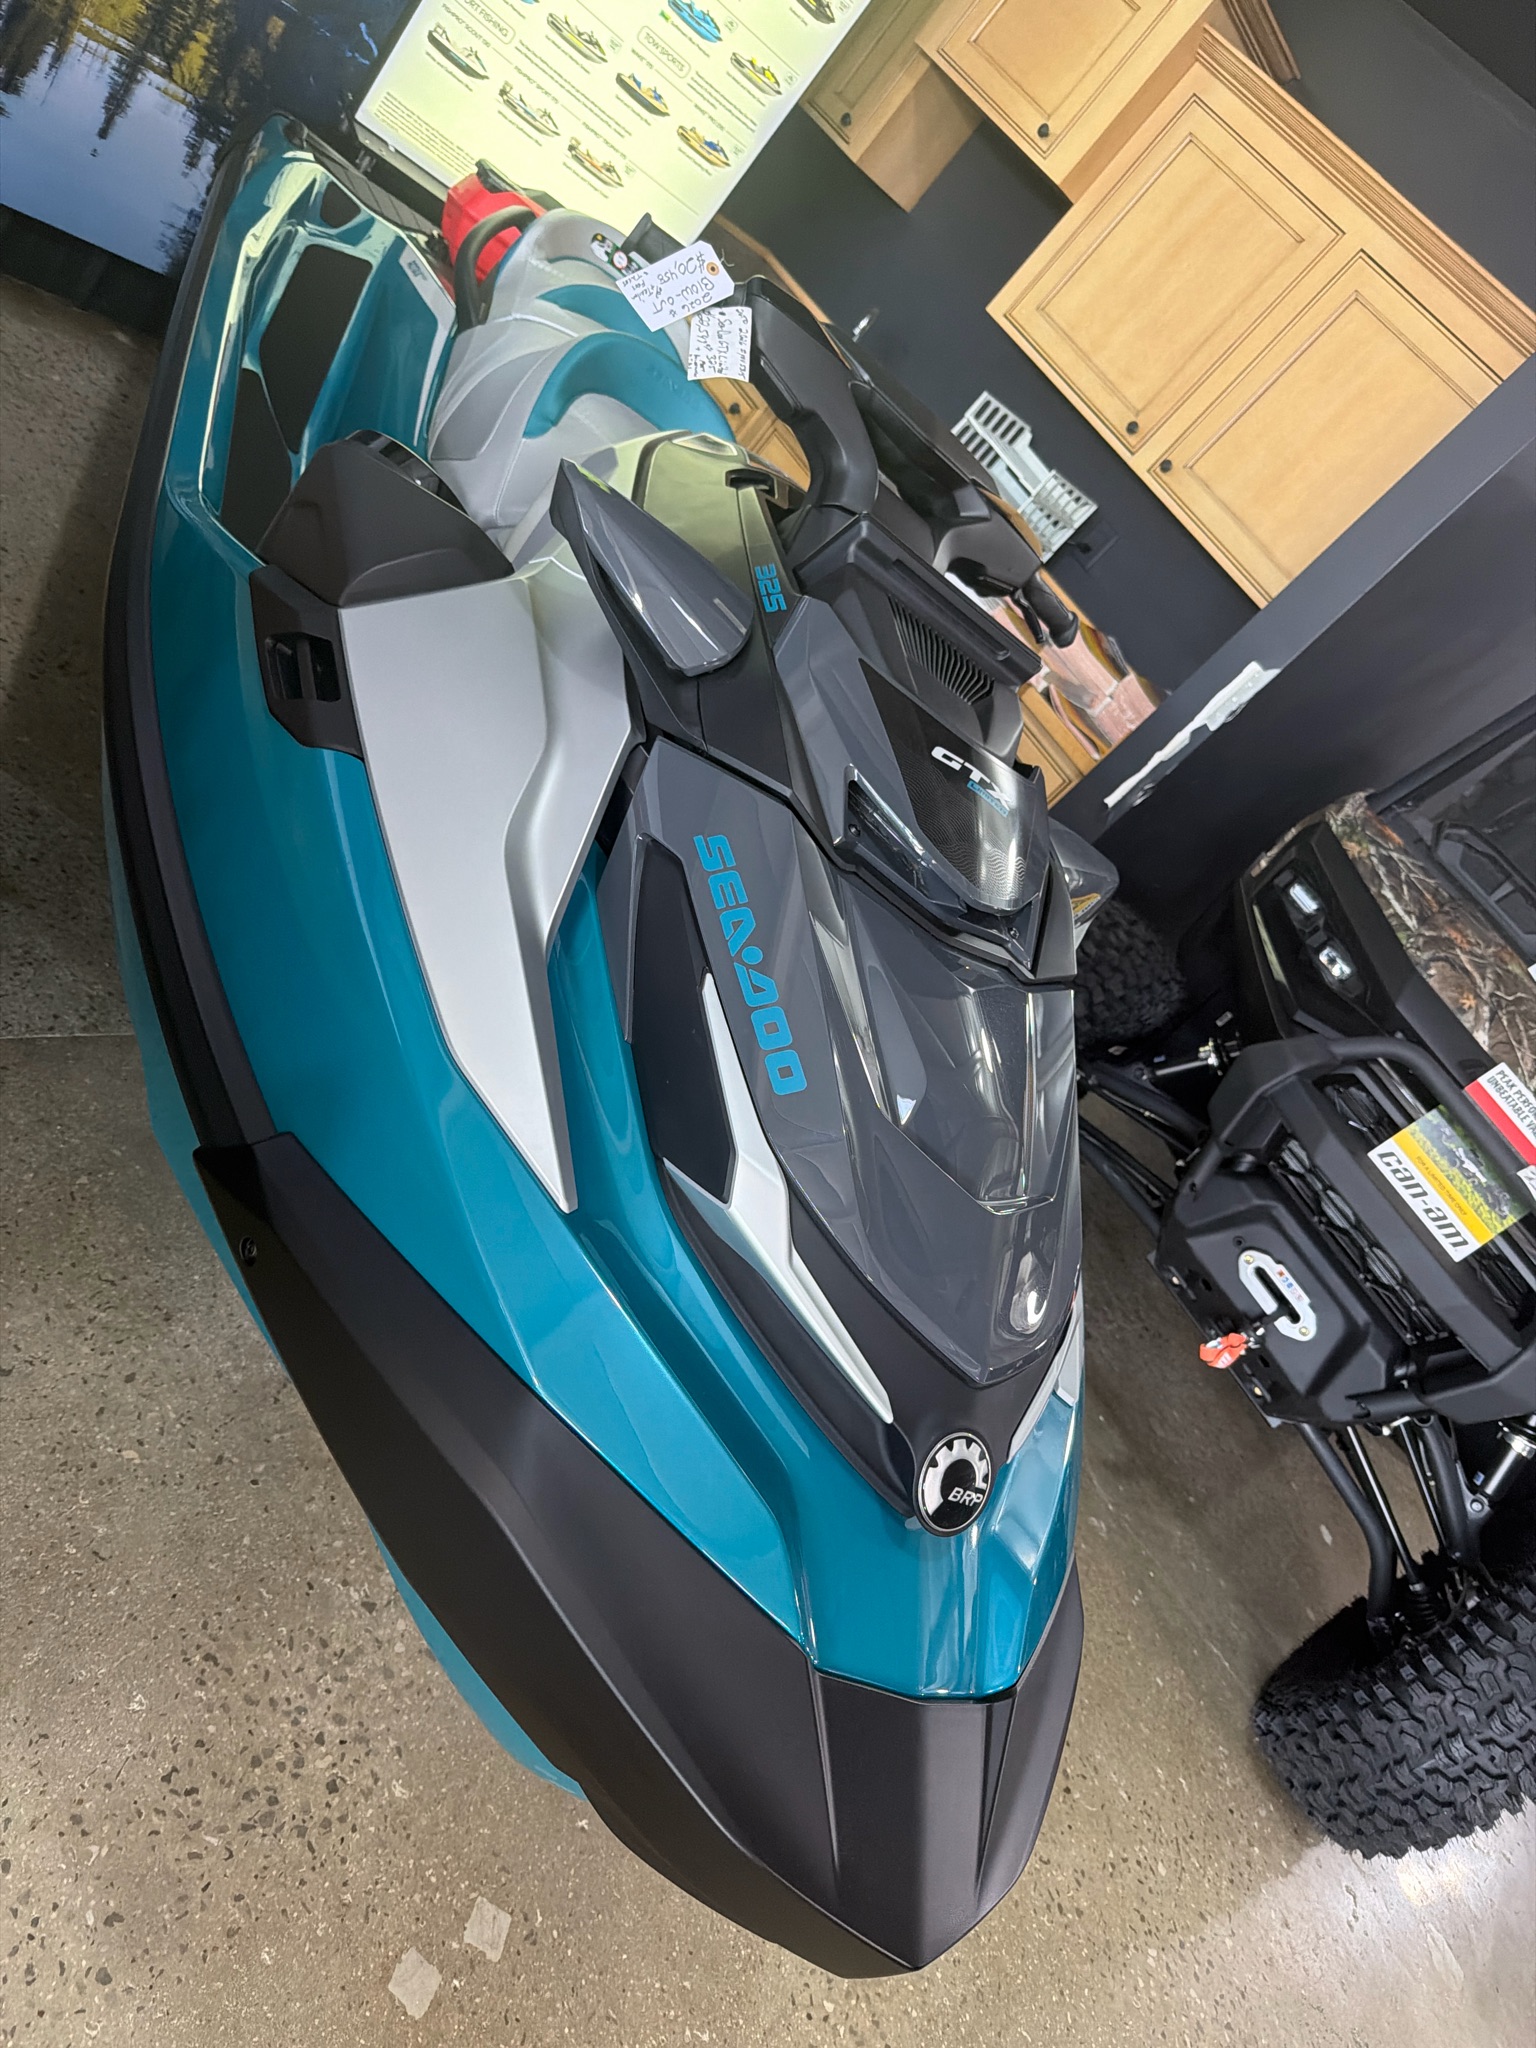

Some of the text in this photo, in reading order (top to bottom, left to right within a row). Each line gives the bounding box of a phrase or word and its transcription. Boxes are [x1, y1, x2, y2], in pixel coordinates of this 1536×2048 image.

[478, 8, 510, 38] FISHING
[682, 292, 712, 312] 2026
[755, 563, 788, 613] 325
[931, 746, 1010, 811] GTX
[1495, 1069, 1517, 1091] PEAK
[1487, 1076, 1531, 1123] UNBEATABLE
[1377, 1151, 1469, 1248] can-am
[948, 1487, 984, 1506] BRP
